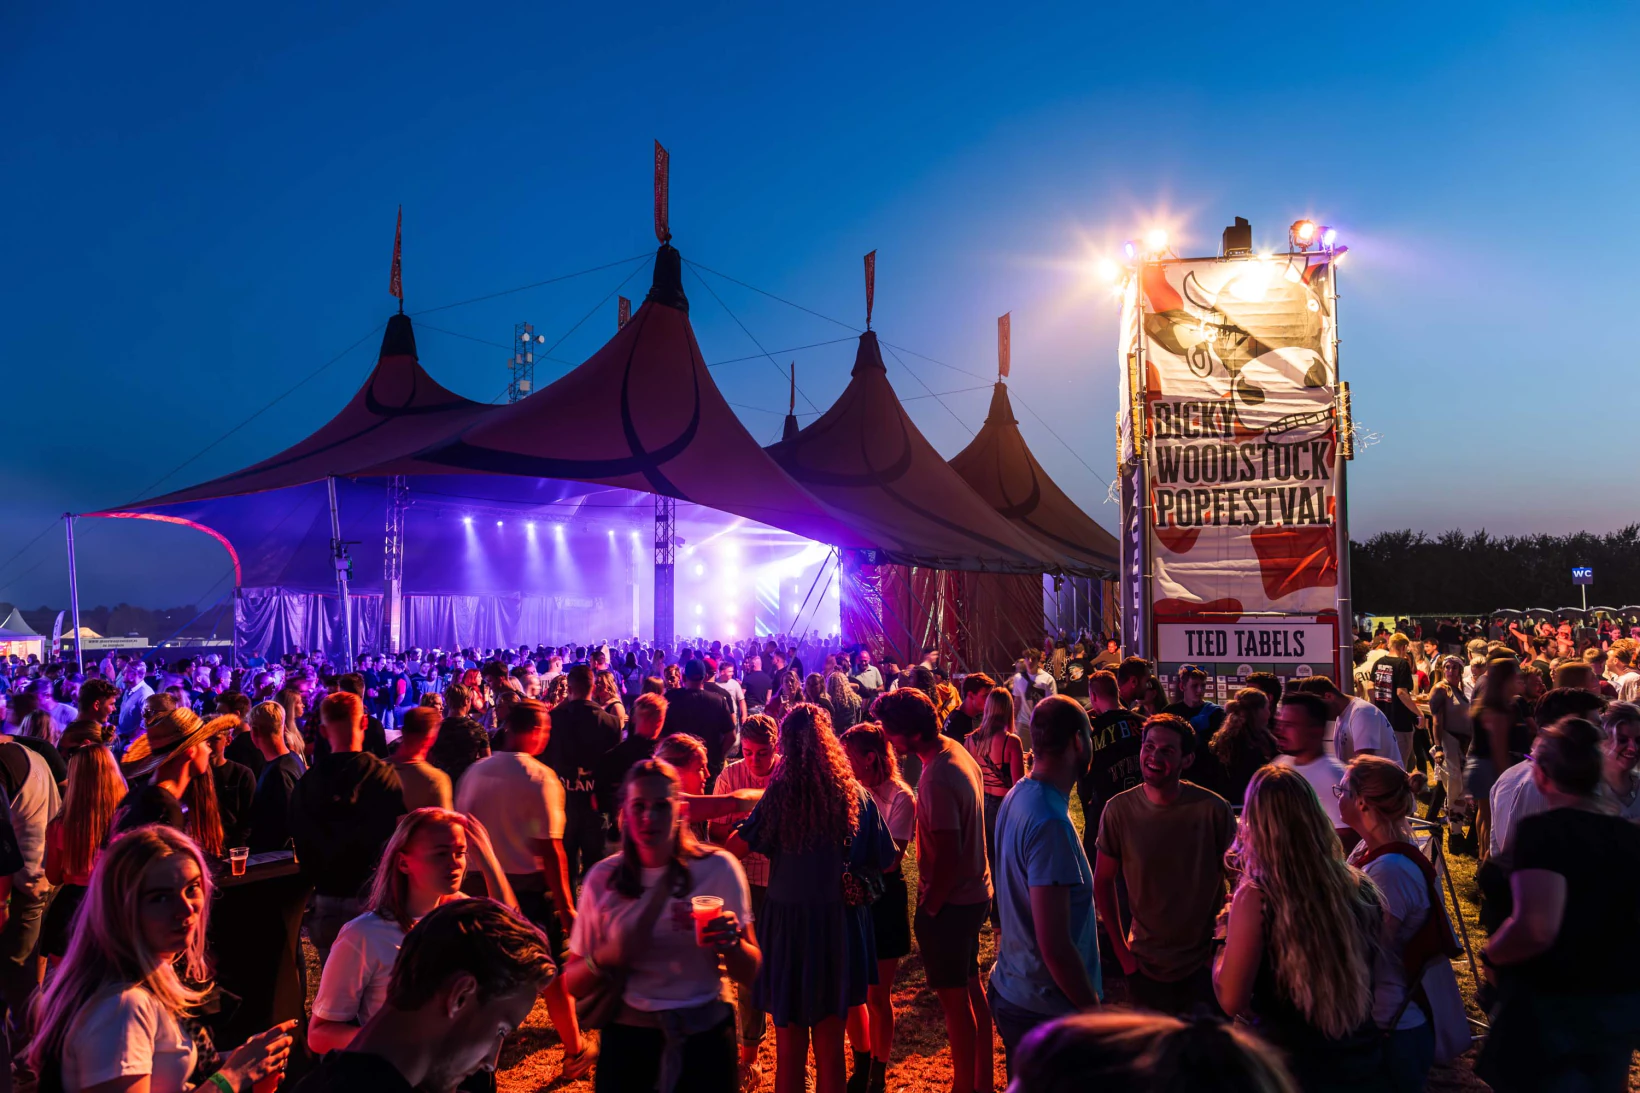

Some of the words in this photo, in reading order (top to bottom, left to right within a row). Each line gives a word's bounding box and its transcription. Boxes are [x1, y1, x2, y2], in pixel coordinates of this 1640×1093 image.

[1153, 400, 1237, 439] DICKY
[1154, 441, 1330, 484] WOODSTOCK
[1573, 570, 1592, 578] WC
[1184, 630, 1228, 657] TIED
[1234, 630, 1305, 657] TABELS
